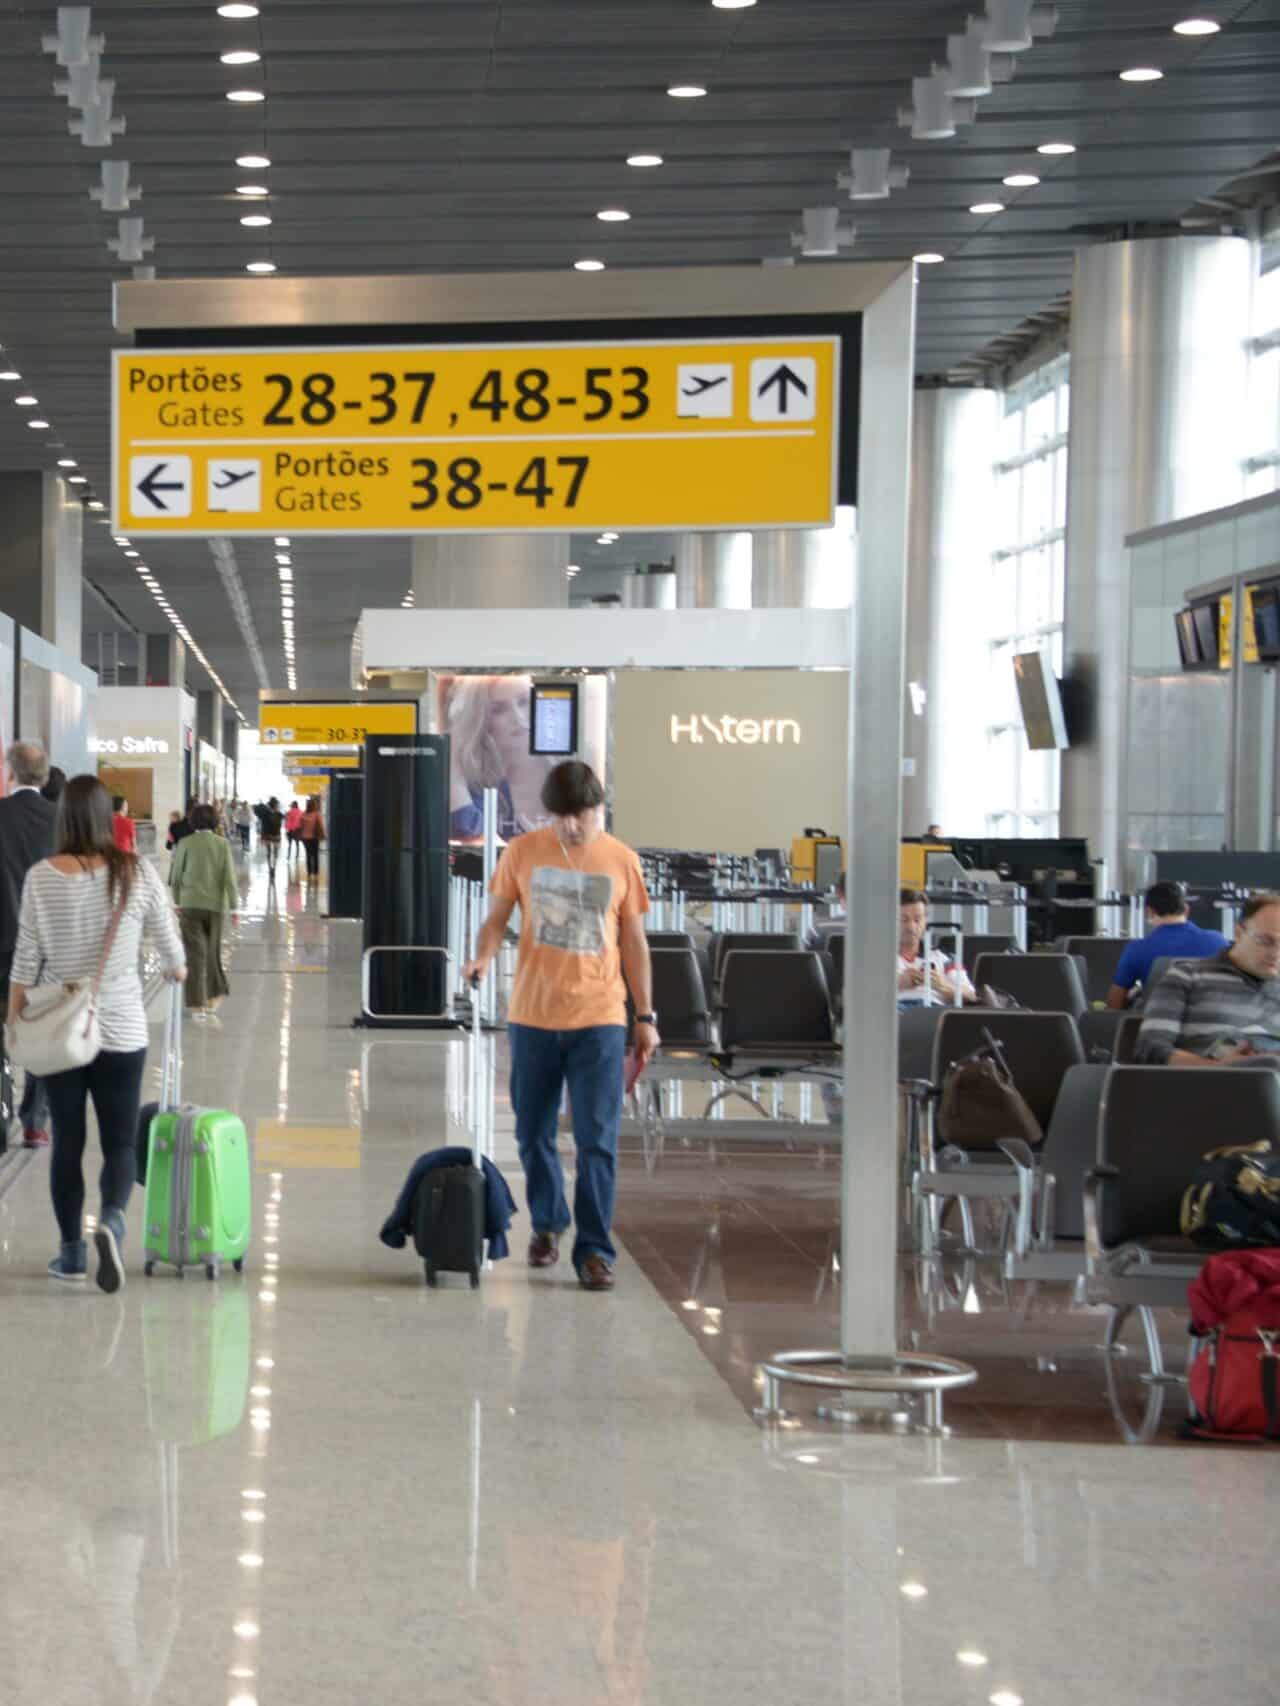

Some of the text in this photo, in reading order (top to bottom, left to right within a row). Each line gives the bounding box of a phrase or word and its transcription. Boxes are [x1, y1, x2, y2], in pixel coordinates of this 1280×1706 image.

[129, 367, 243, 393] Portões
[157, 402, 244, 428] Gates
[275, 450, 389, 477] Portões
[410, 456, 590, 511] 38-47
[274, 486, 362, 512] Gates
